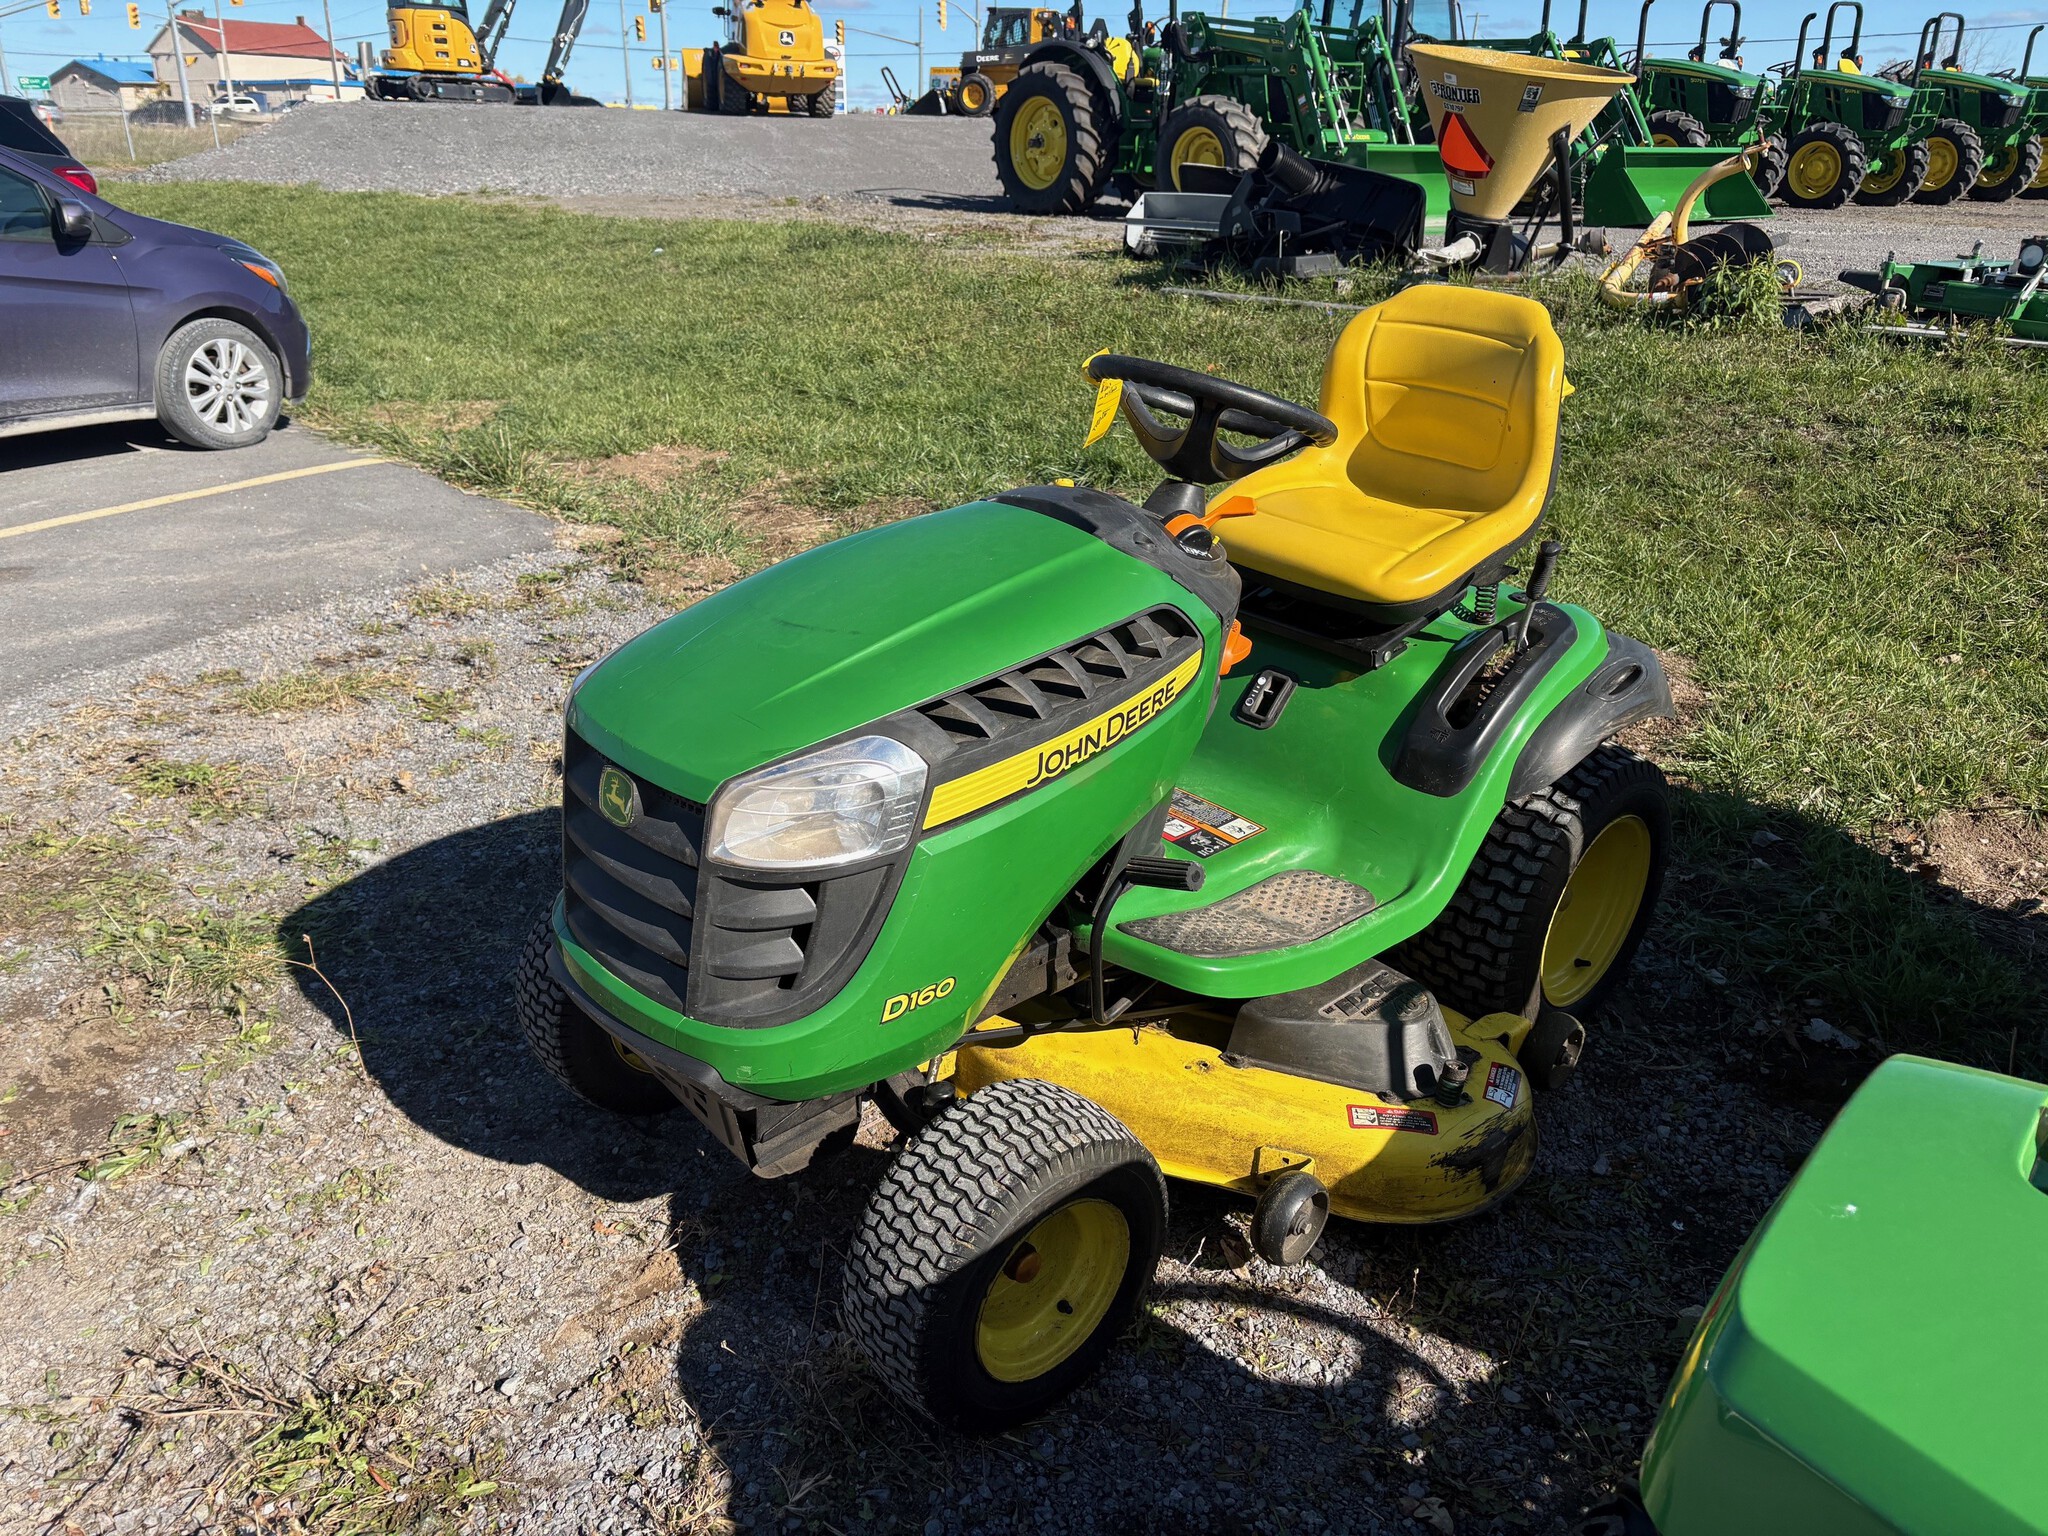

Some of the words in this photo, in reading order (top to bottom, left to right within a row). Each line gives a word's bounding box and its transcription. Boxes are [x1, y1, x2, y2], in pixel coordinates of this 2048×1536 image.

[1437, 83, 1480, 104] FRONTIER
[1027, 727, 1101, 785] JOHN
[1106, 676, 1177, 743] DEERE
[879, 976, 957, 1025] D160
[1334, 974, 1396, 1017] EDGE
